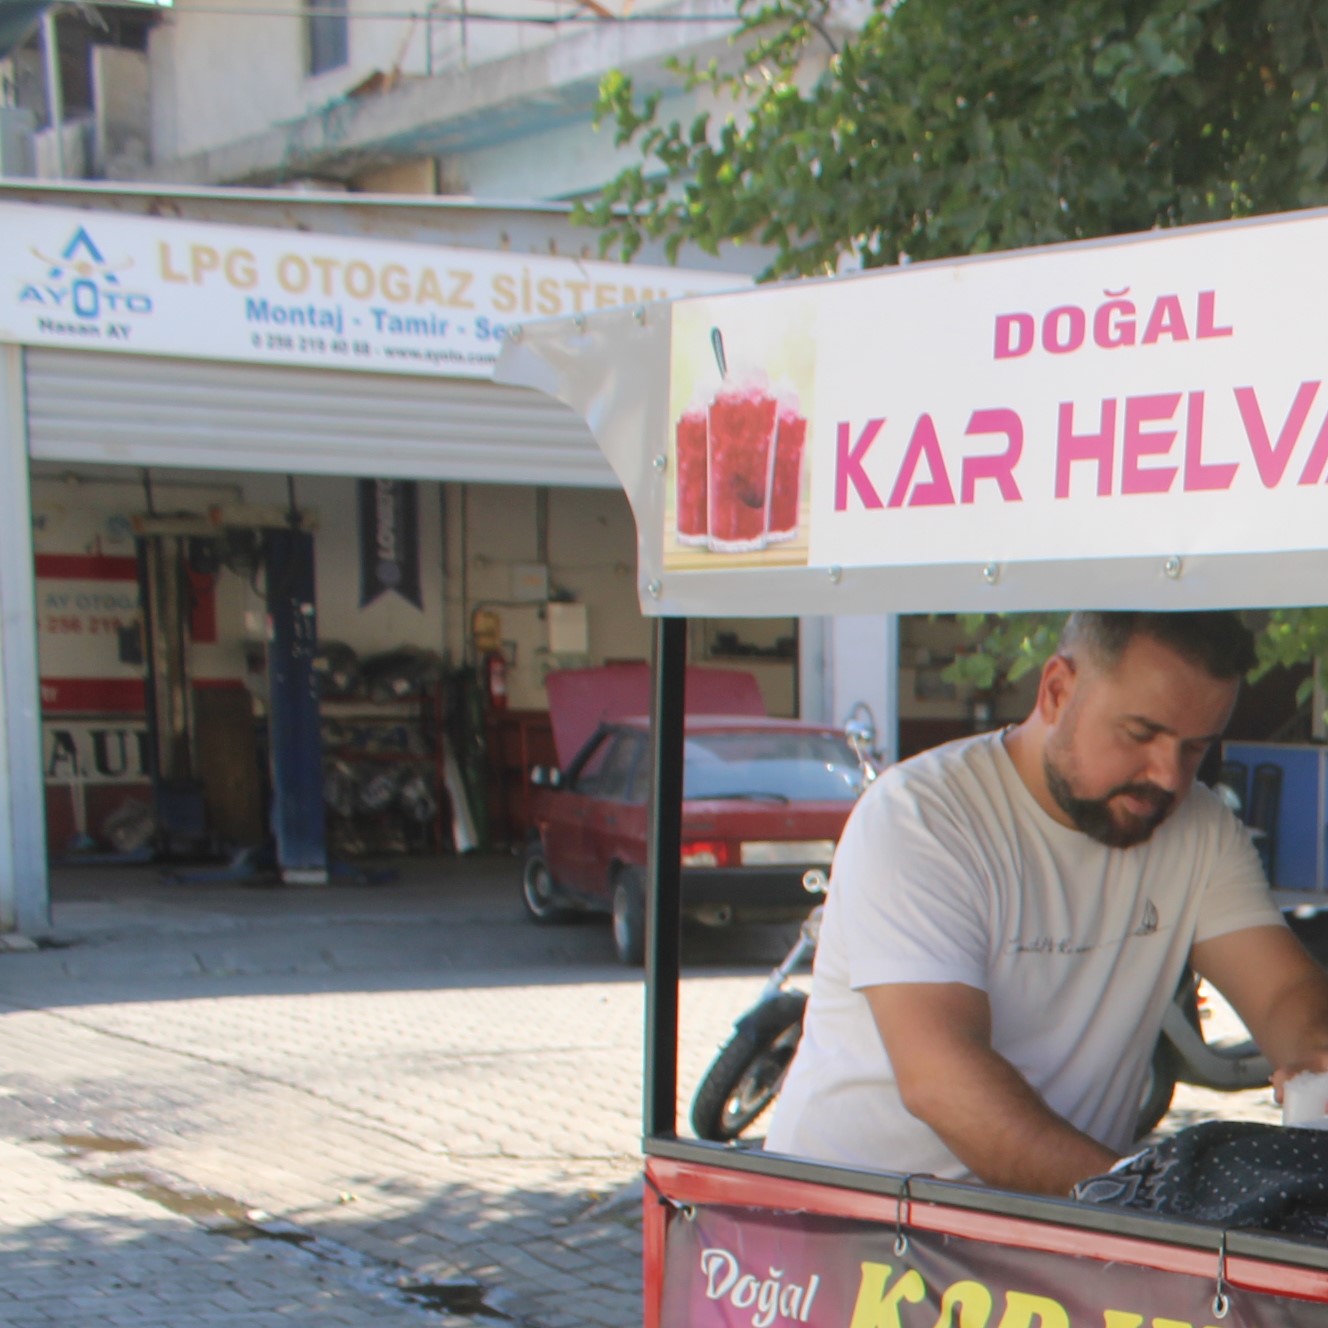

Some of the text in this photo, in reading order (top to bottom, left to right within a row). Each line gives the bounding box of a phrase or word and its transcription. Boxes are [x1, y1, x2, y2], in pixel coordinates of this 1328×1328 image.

[18, 279, 153, 319] AYOTO
[156, 240, 260, 293] LPG
[276, 253, 475, 311] OTOGAZ
[245, 297, 343, 334] Montaj
[370, 307, 449, 337] Tamir
[993, 286, 1234, 361] DOĞAL
[833, 408, 1024, 512] KAR
[700, 1247, 819, 1328] Doğal
